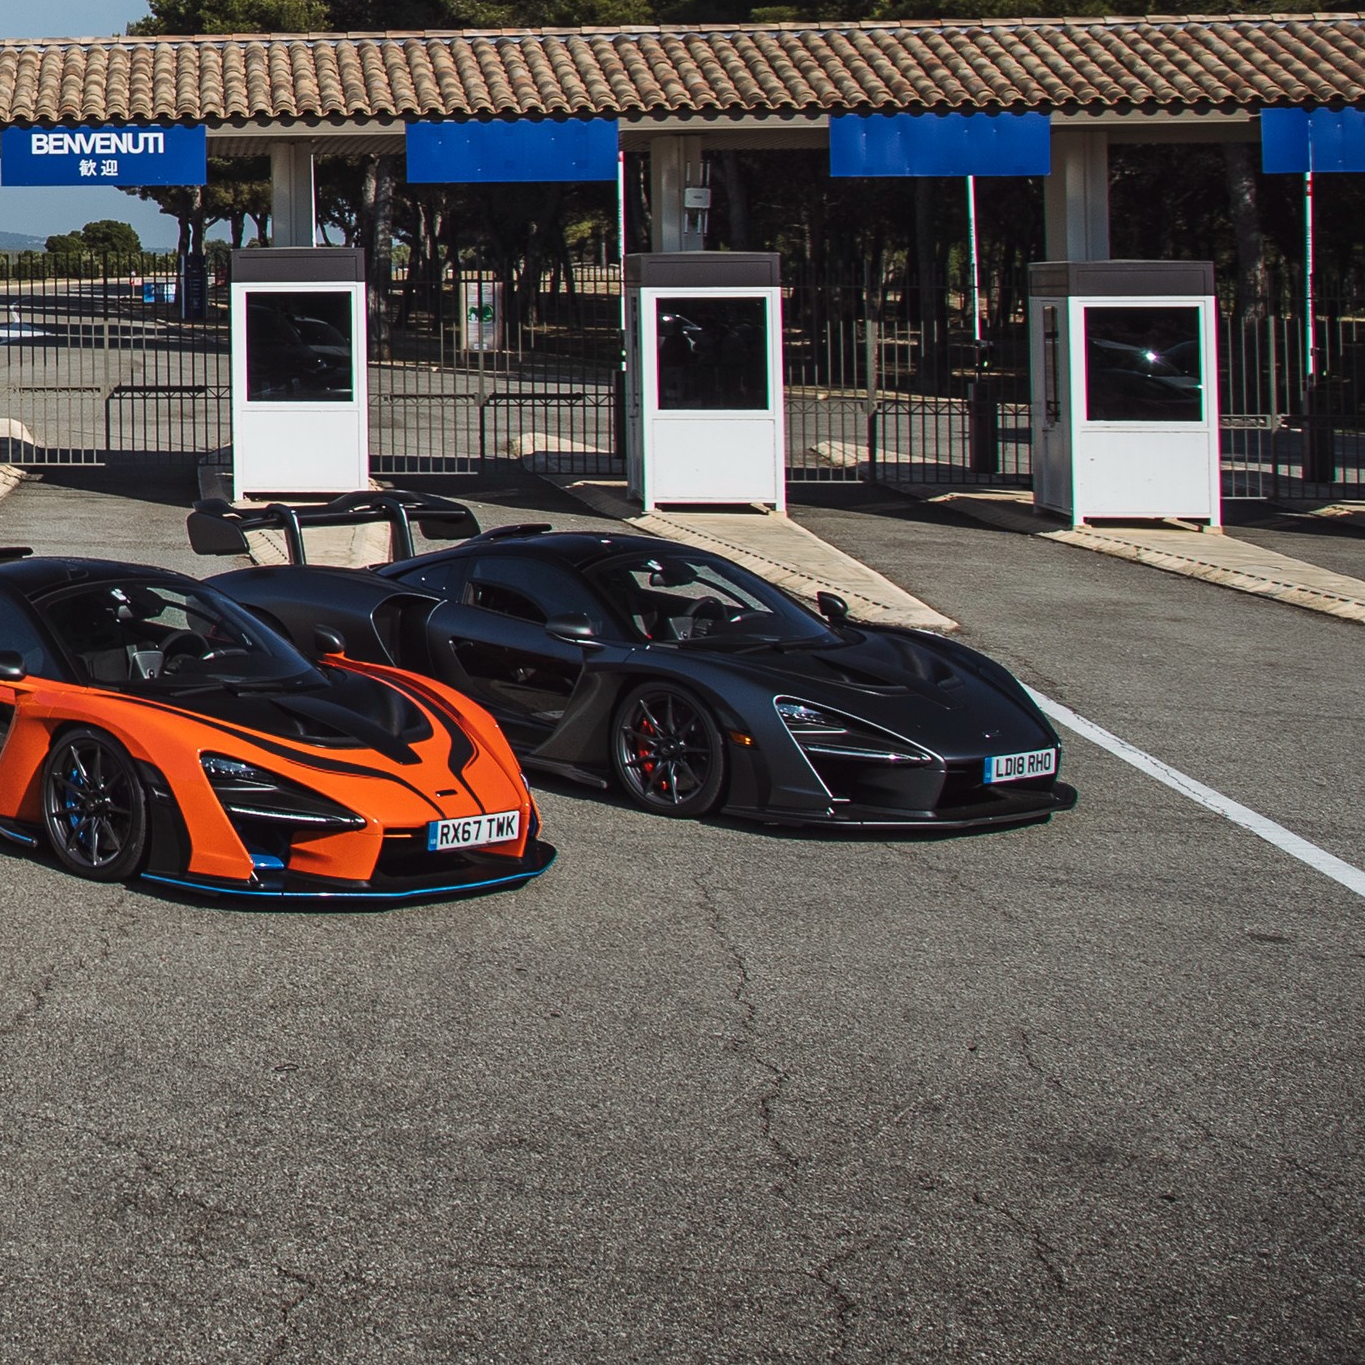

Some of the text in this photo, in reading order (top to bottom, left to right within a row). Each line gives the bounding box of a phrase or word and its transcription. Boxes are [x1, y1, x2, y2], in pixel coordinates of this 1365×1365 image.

[31, 132, 164, 155] BENVENUTI
[996, 755, 1025, 778] LD18
[440, 815, 516, 846] RX67 TWK
